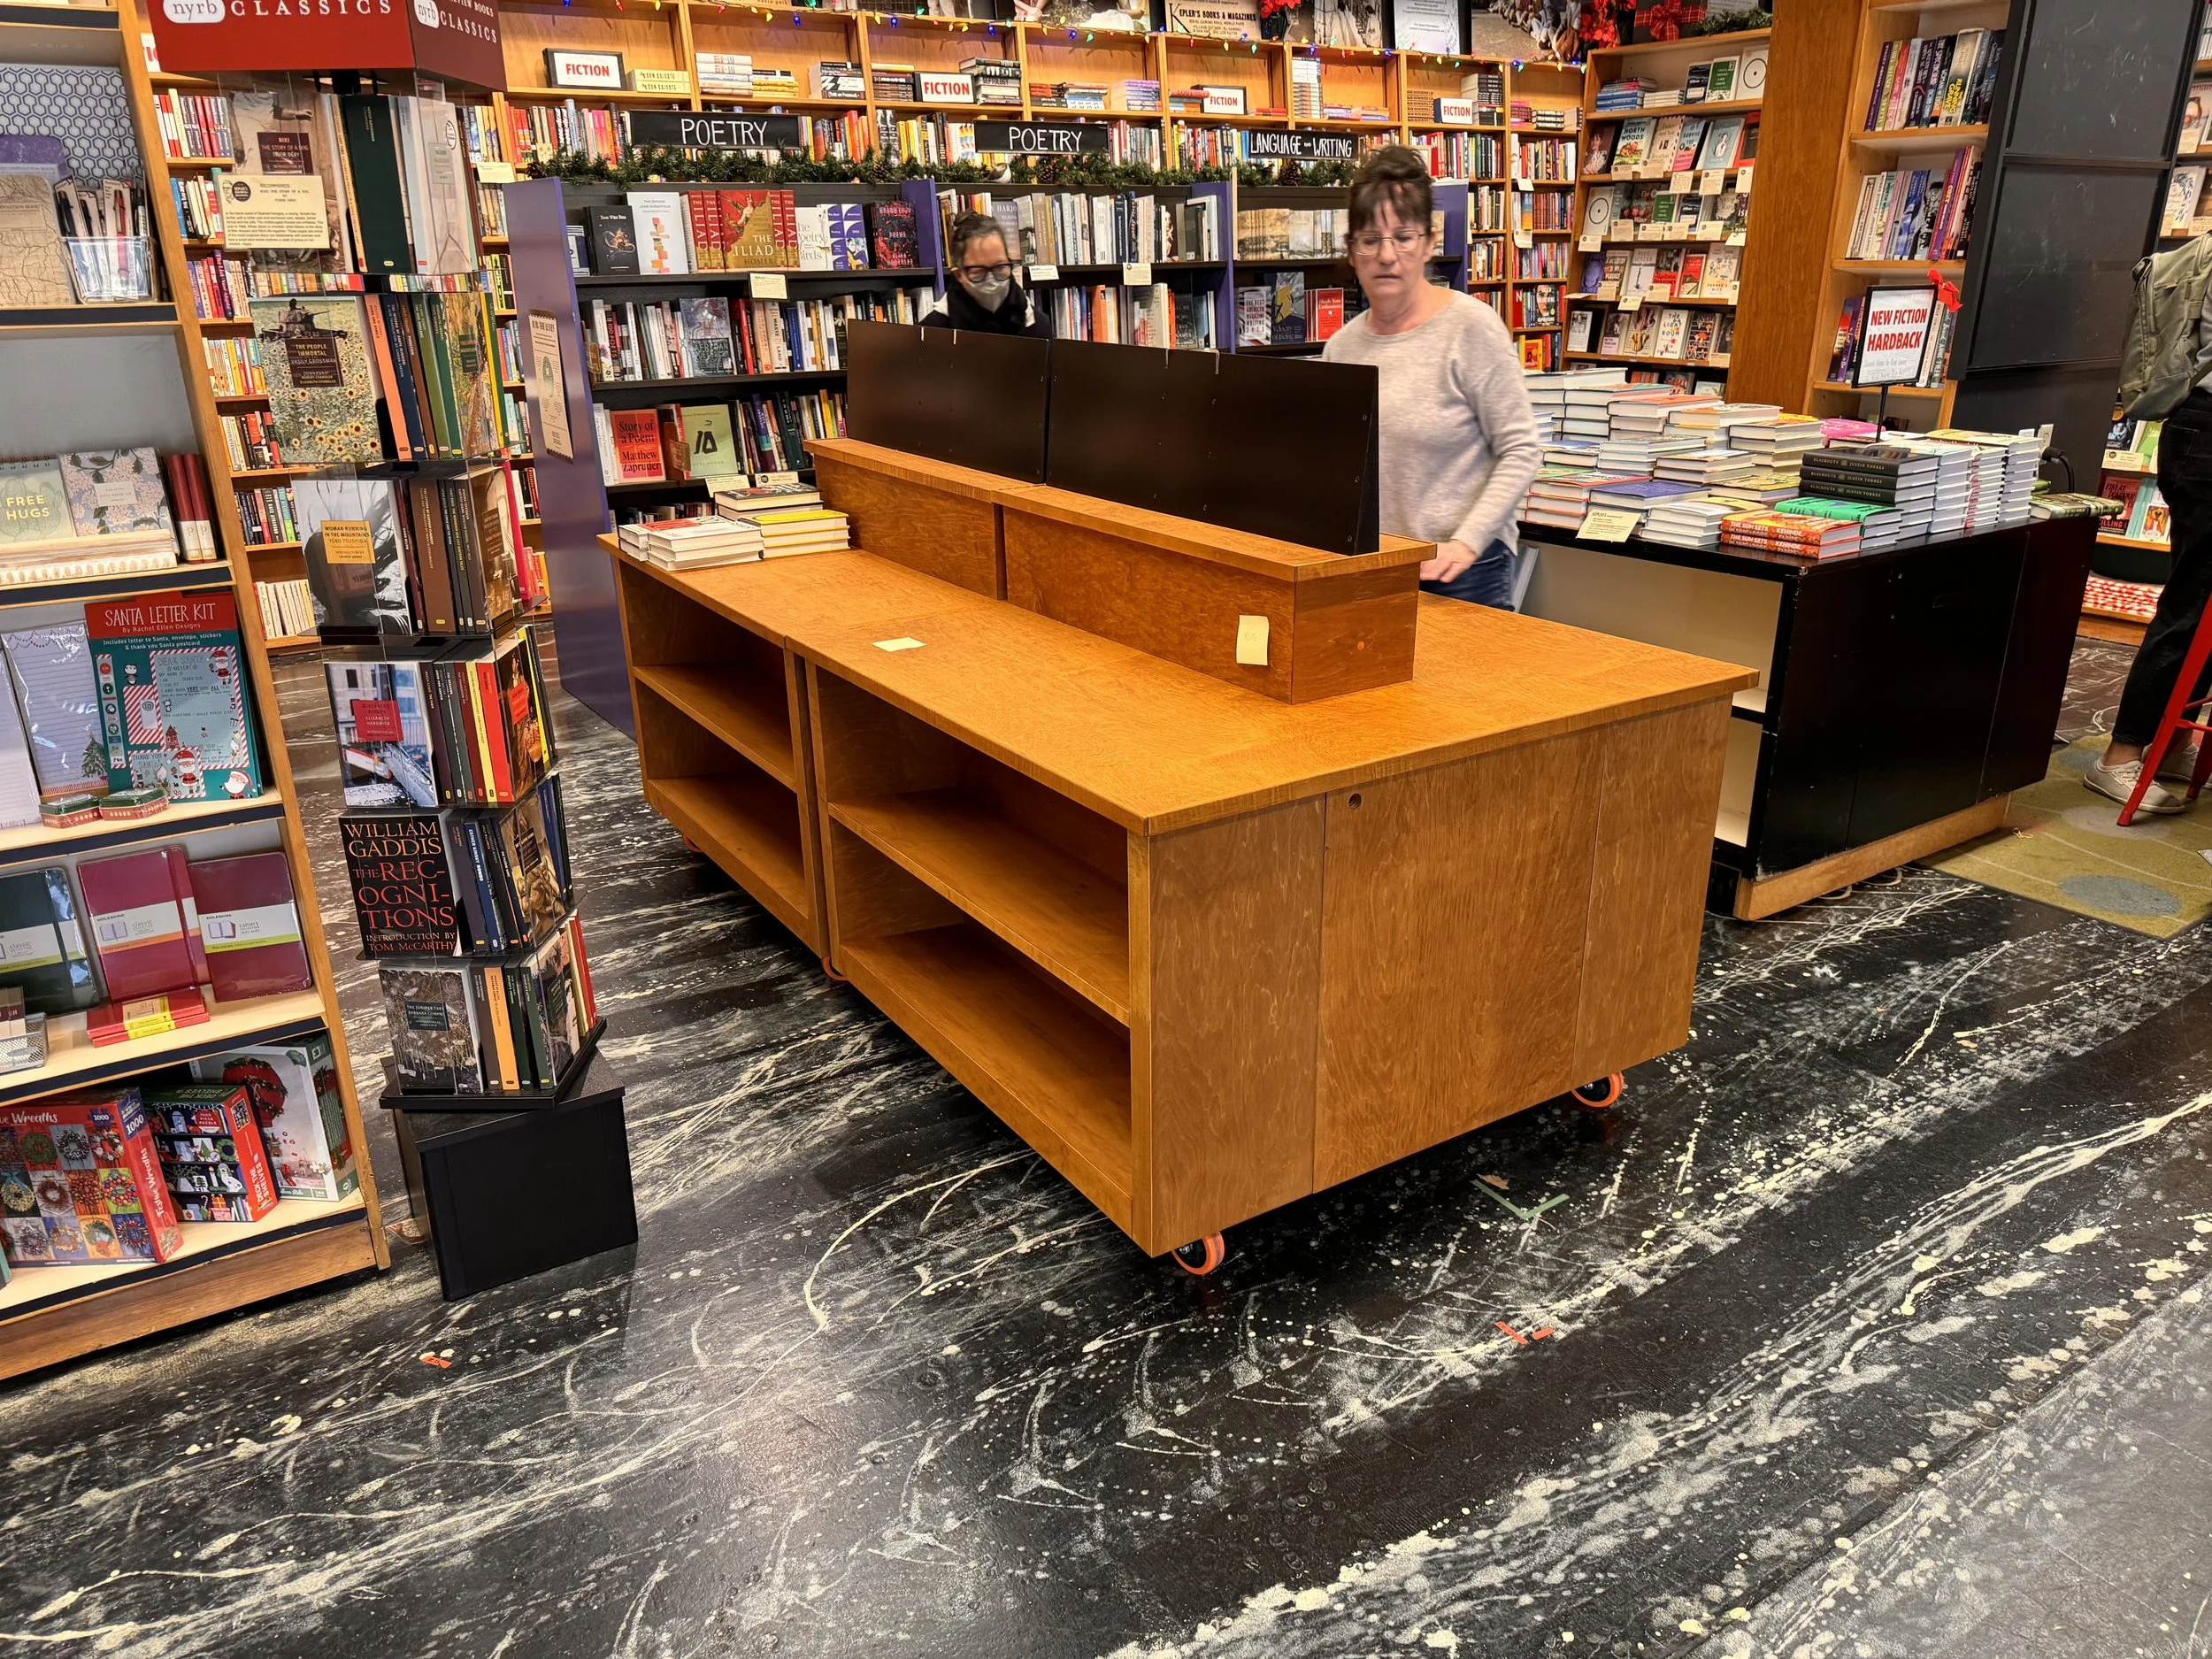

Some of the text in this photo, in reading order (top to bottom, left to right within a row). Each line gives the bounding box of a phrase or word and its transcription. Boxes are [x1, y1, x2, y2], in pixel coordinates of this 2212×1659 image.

[173, 0, 392, 21] nyrb CLASSICS
[473, 1, 495, 18] BOOKS
[1227, 12, 1256, 21] MAGAZINES
[417, 2, 497, 43] nyrb CLASSICS
[565, 63, 610, 77] FICTION
[923, 81, 970, 96] FICTION
[982, 77, 1010, 86] SEPTOLOGY
[1210, 96, 1238, 106] FICTION
[1945, 83, 1955, 110] GRAVE
[1951, 78, 1963, 113] RUNNING
[1443, 105, 1471, 117] FICTION
[681, 118, 768, 146] POETRY
[1009, 126, 1083, 151] POETRY
[1249, 133, 1352, 157] LANGUAGE WRITING
[694, 207, 708, 251] ILIAD
[707, 207, 721, 251] ILIAD
[772, 206, 784, 249] ILIAD
[785, 206, 797, 249] ILIAD
[734, 244, 774, 257] ILIAD
[1870, 308, 1928, 326] NEW FICTION
[1867, 331, 1924, 352] HARDBACK
[618, 419, 655, 433] Story of
[621, 433, 655, 445] a Poem
[622, 449, 657, 462] Matthew
[621, 463, 661, 473] Zapruder
[6, 495, 45, 506] FREE
[6, 508, 50, 520] HUGS
[1776, 527, 1803, 536] KEHINDE
[104, 603, 216, 626] SANTA LETTER KIT
[175, 622, 201, 631] Designs
[343, 821, 439, 839] WILLIAM
[348, 837, 442, 857] GADDIS
[352, 860, 445, 881] THE REC-
[357, 883, 450, 906] OGNI-
[96, 913, 125, 922] MOLESKINE
[132, 919, 153, 928] classic
[361, 907, 455, 929] TIONS
[365, 932, 457, 942] INTRODUCTION BY
[368, 941, 455, 952] TOM McCARTHY
[12, 1110, 58, 1124] Wreaths
[126, 1114, 145, 1136] 1000
[141, 1147, 165, 1218] Festive Wreaths
[250, 1167, 265, 1202] DECK THE
[255, 1162, 270, 1200] SHELVES
